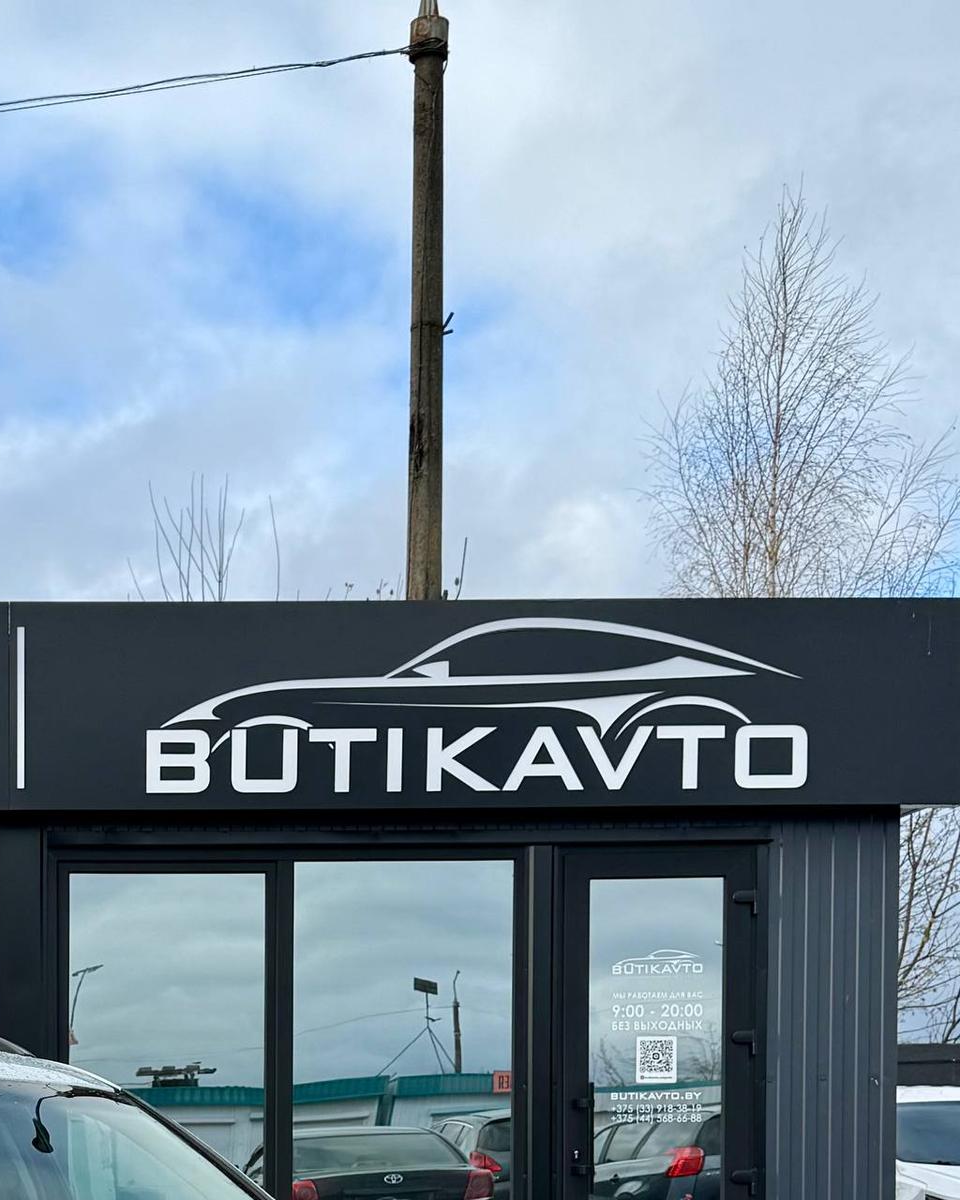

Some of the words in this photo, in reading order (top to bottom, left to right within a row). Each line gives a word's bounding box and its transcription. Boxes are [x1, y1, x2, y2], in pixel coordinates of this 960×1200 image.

[145, 723, 809, 795] BUTIKAVTO
[612, 963, 703, 975] BUTIKAVTO
[612, 1004, 644, 1018] 9:00
[661, 1003, 703, 1018] 20:00
[612, 1021, 630, 1031] БЕЗ
[634, 1020, 703, 1031] ВЫХОДНЫХ
[610, 1092, 702, 1100] BUTIKAVTO.BY
[611, 1104, 634, 1113] +375
[636, 1103, 654, 1116] (33)
[656, 1103, 702, 1113] 918-38-19
[611, 1114, 634, 1123] +375
[636, 1113, 654, 1125] (44)
[656, 1113, 702, 1123] 568-66-88
